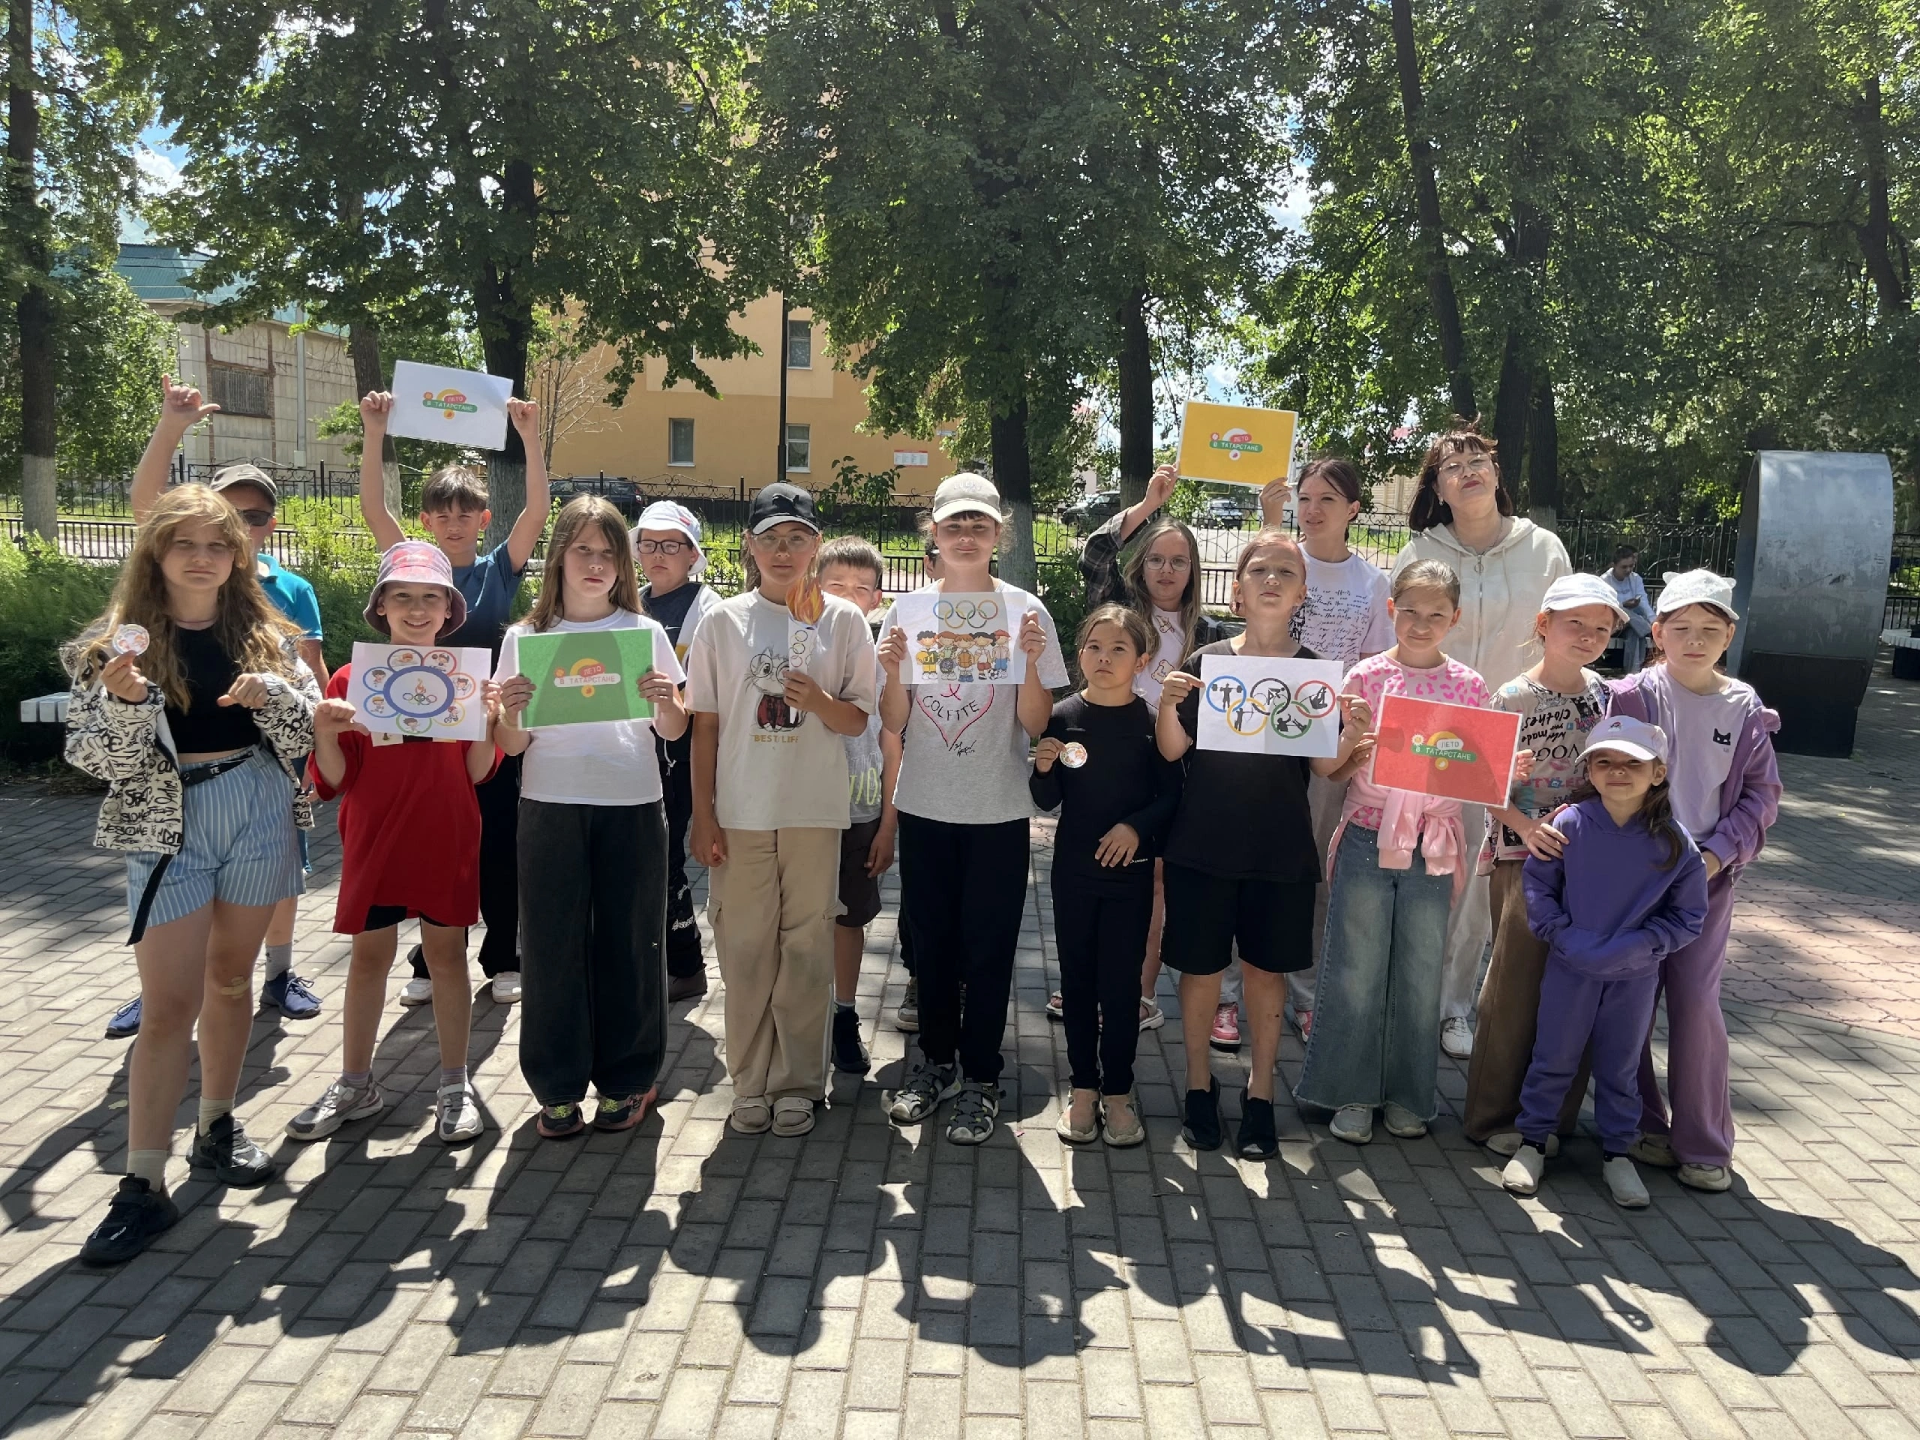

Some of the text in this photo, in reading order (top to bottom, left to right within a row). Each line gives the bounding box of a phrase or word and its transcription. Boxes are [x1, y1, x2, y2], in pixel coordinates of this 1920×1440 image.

[435, 401, 473, 411] ТАТАРСТАНЕ
[1221, 442, 1258, 451] ТАТАРСТАНЕ
[569, 676, 616, 684] ТАТАРСТАНЕ
[754, 734, 778, 743] BEST
[1441, 740, 1460, 748] ЛЕТО
[1425, 747, 1471, 761] ТАТАРСТАНЕ
[1531, 743, 1580, 762] VOG
